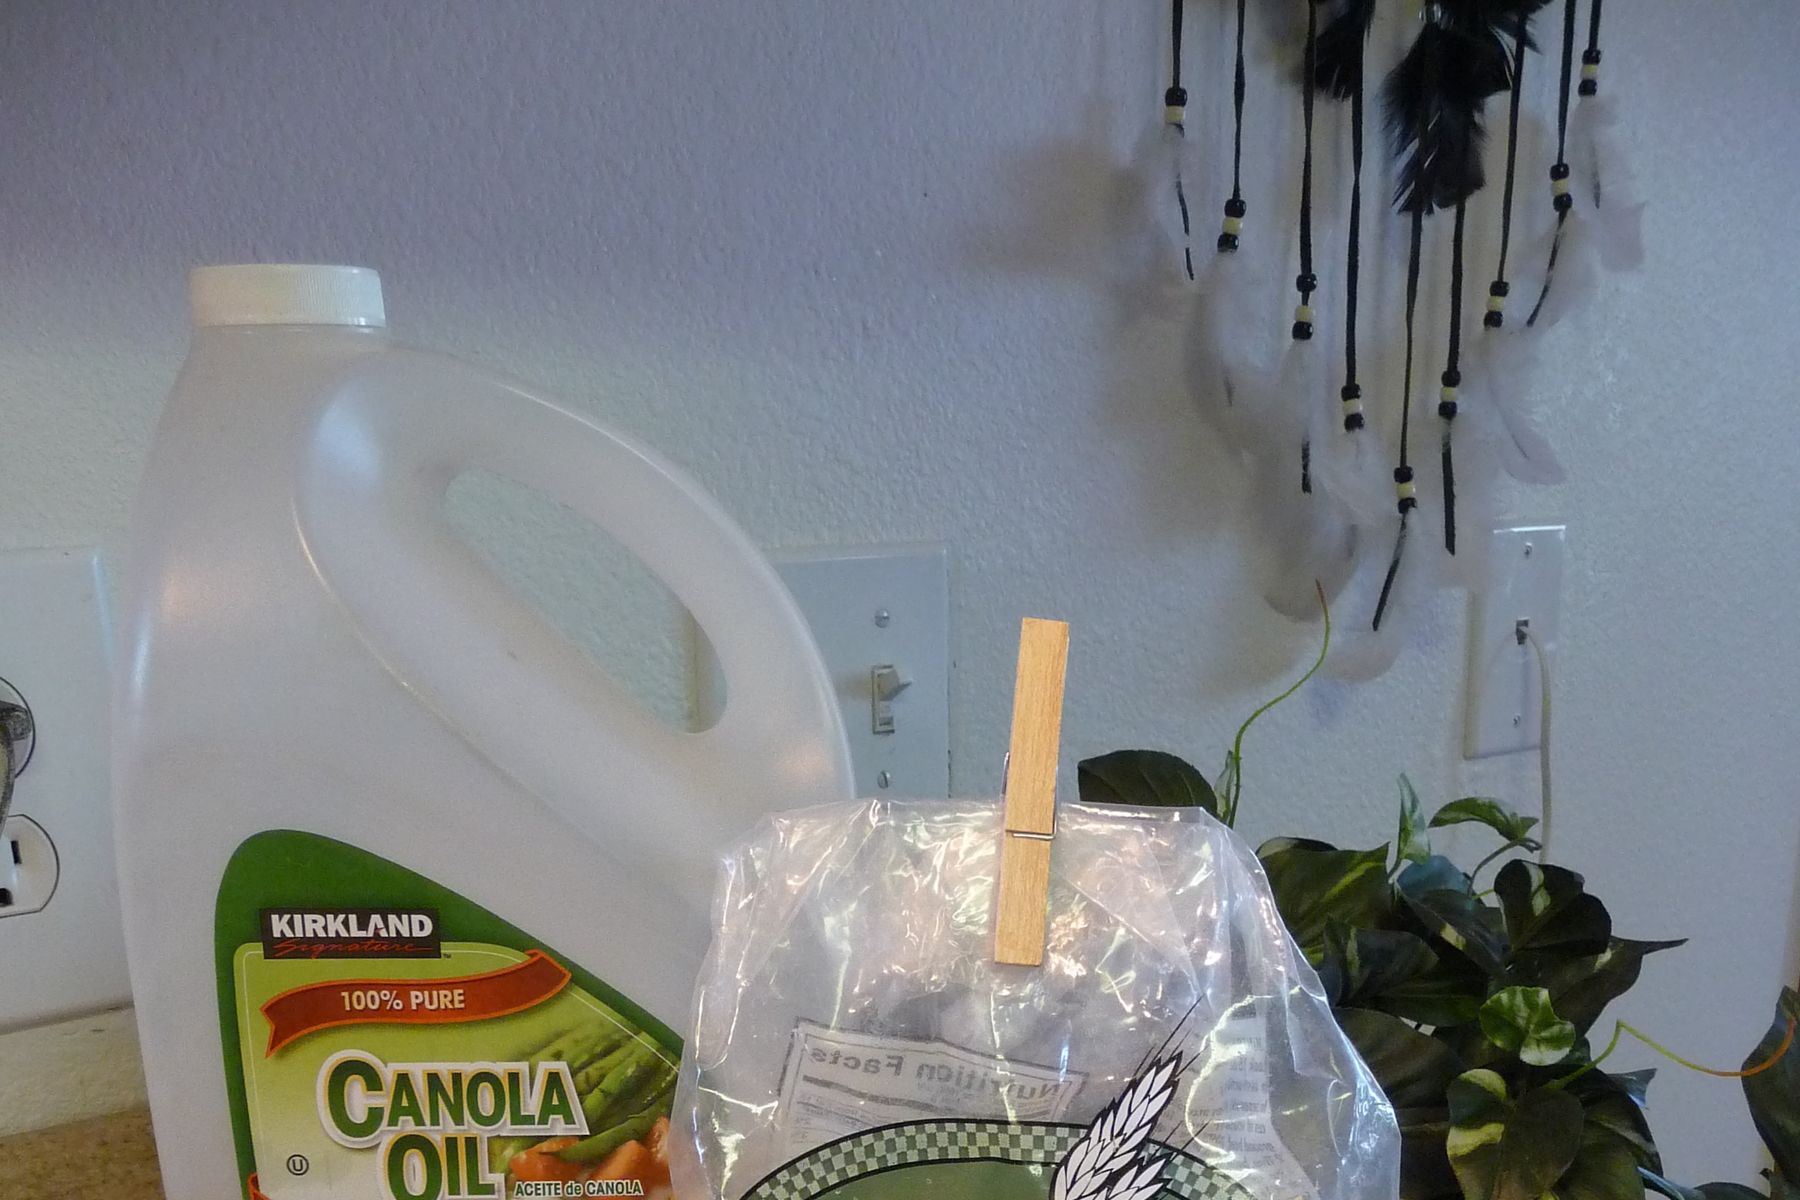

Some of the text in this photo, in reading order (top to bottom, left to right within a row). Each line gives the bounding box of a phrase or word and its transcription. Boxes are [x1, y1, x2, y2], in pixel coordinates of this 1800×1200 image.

[270, 914, 433, 938] KIRKLAND
[273, 939, 432, 959] Signature
[341, 989, 466, 1011] 100% PURE
[325, 1057, 578, 1140] CANOLA
[514, 1180, 642, 1196] ACEITE de CANOLA
